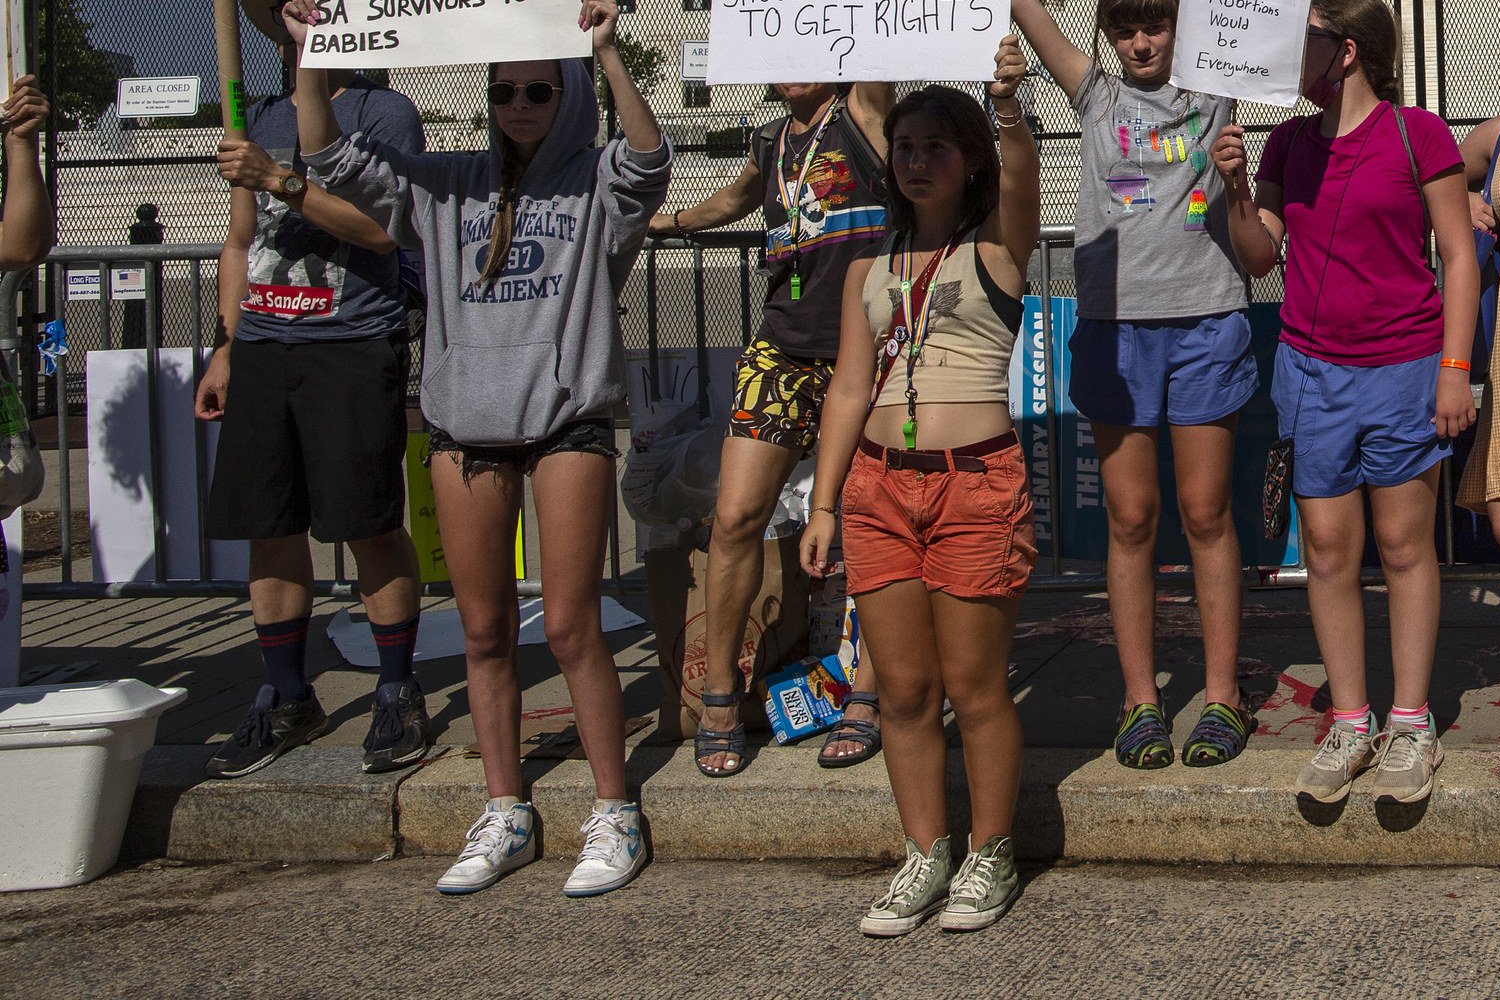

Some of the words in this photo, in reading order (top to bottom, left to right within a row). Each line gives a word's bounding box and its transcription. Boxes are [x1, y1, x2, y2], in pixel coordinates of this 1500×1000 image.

[316, 0, 349, 26] SA
[739, 7, 782, 37] TO
[794, 3, 864, 36] GET
[1209, 9, 1250, 31] Would
[309, 30, 401, 55] BABIES
[691, 47, 709, 56] ARE
[1217, 32, 1239, 50] be
[829, 36, 856, 77] ?
[1195, 51, 1270, 78] Everywhere
[128, 84, 153, 94] AREA
[156, 83, 191, 93] CLOSED
[265, 290, 328, 312] Sanders
[1033, 311, 1054, 416] SESSION
[1031, 423, 1052, 541] PLENARY
[1076, 455, 1100, 509] THE
[782, 690, 804, 726] NUTRI
[790, 690, 810, 723] GRAIN
